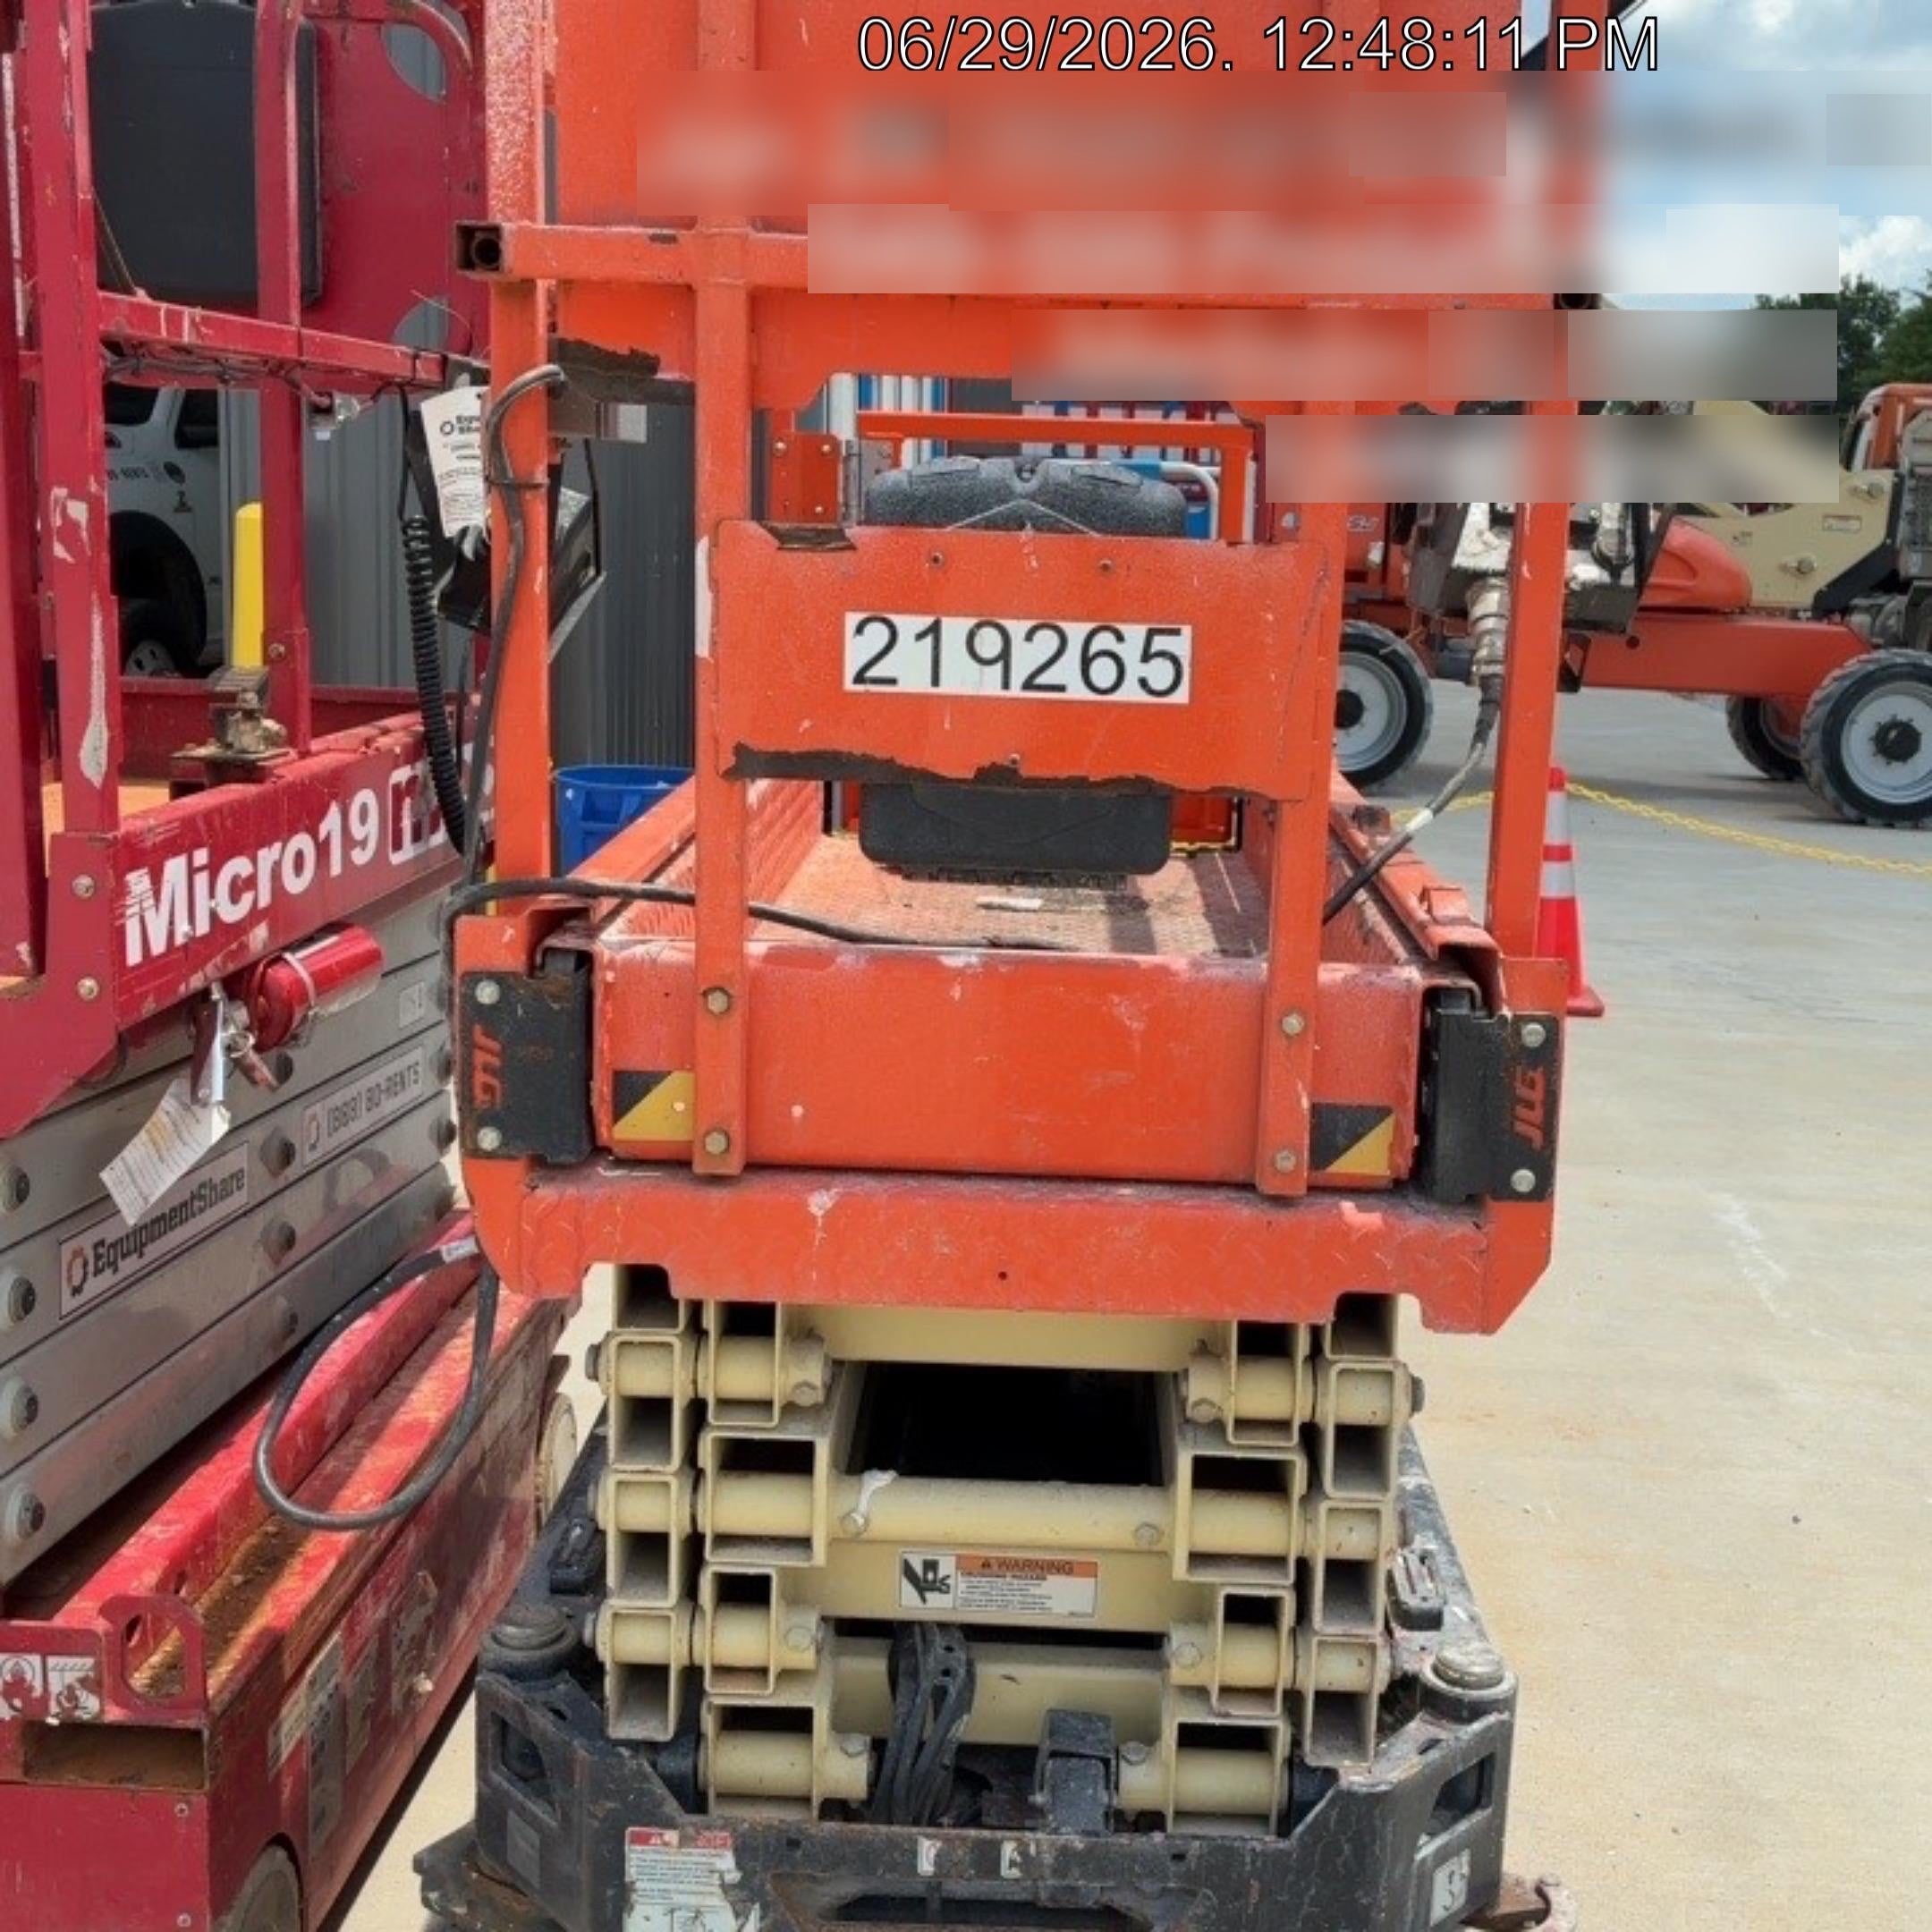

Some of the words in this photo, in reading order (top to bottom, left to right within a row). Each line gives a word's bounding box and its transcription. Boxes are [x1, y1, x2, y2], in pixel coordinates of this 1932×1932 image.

[852, 614, 1184, 698] 219265
[472, 1024, 504, 1109] JLG
[1513, 1065, 1546, 1151] JLG
[92, 1166, 246, 1278] EquipmentShare
[997, 1557, 1074, 1576] WARNING
